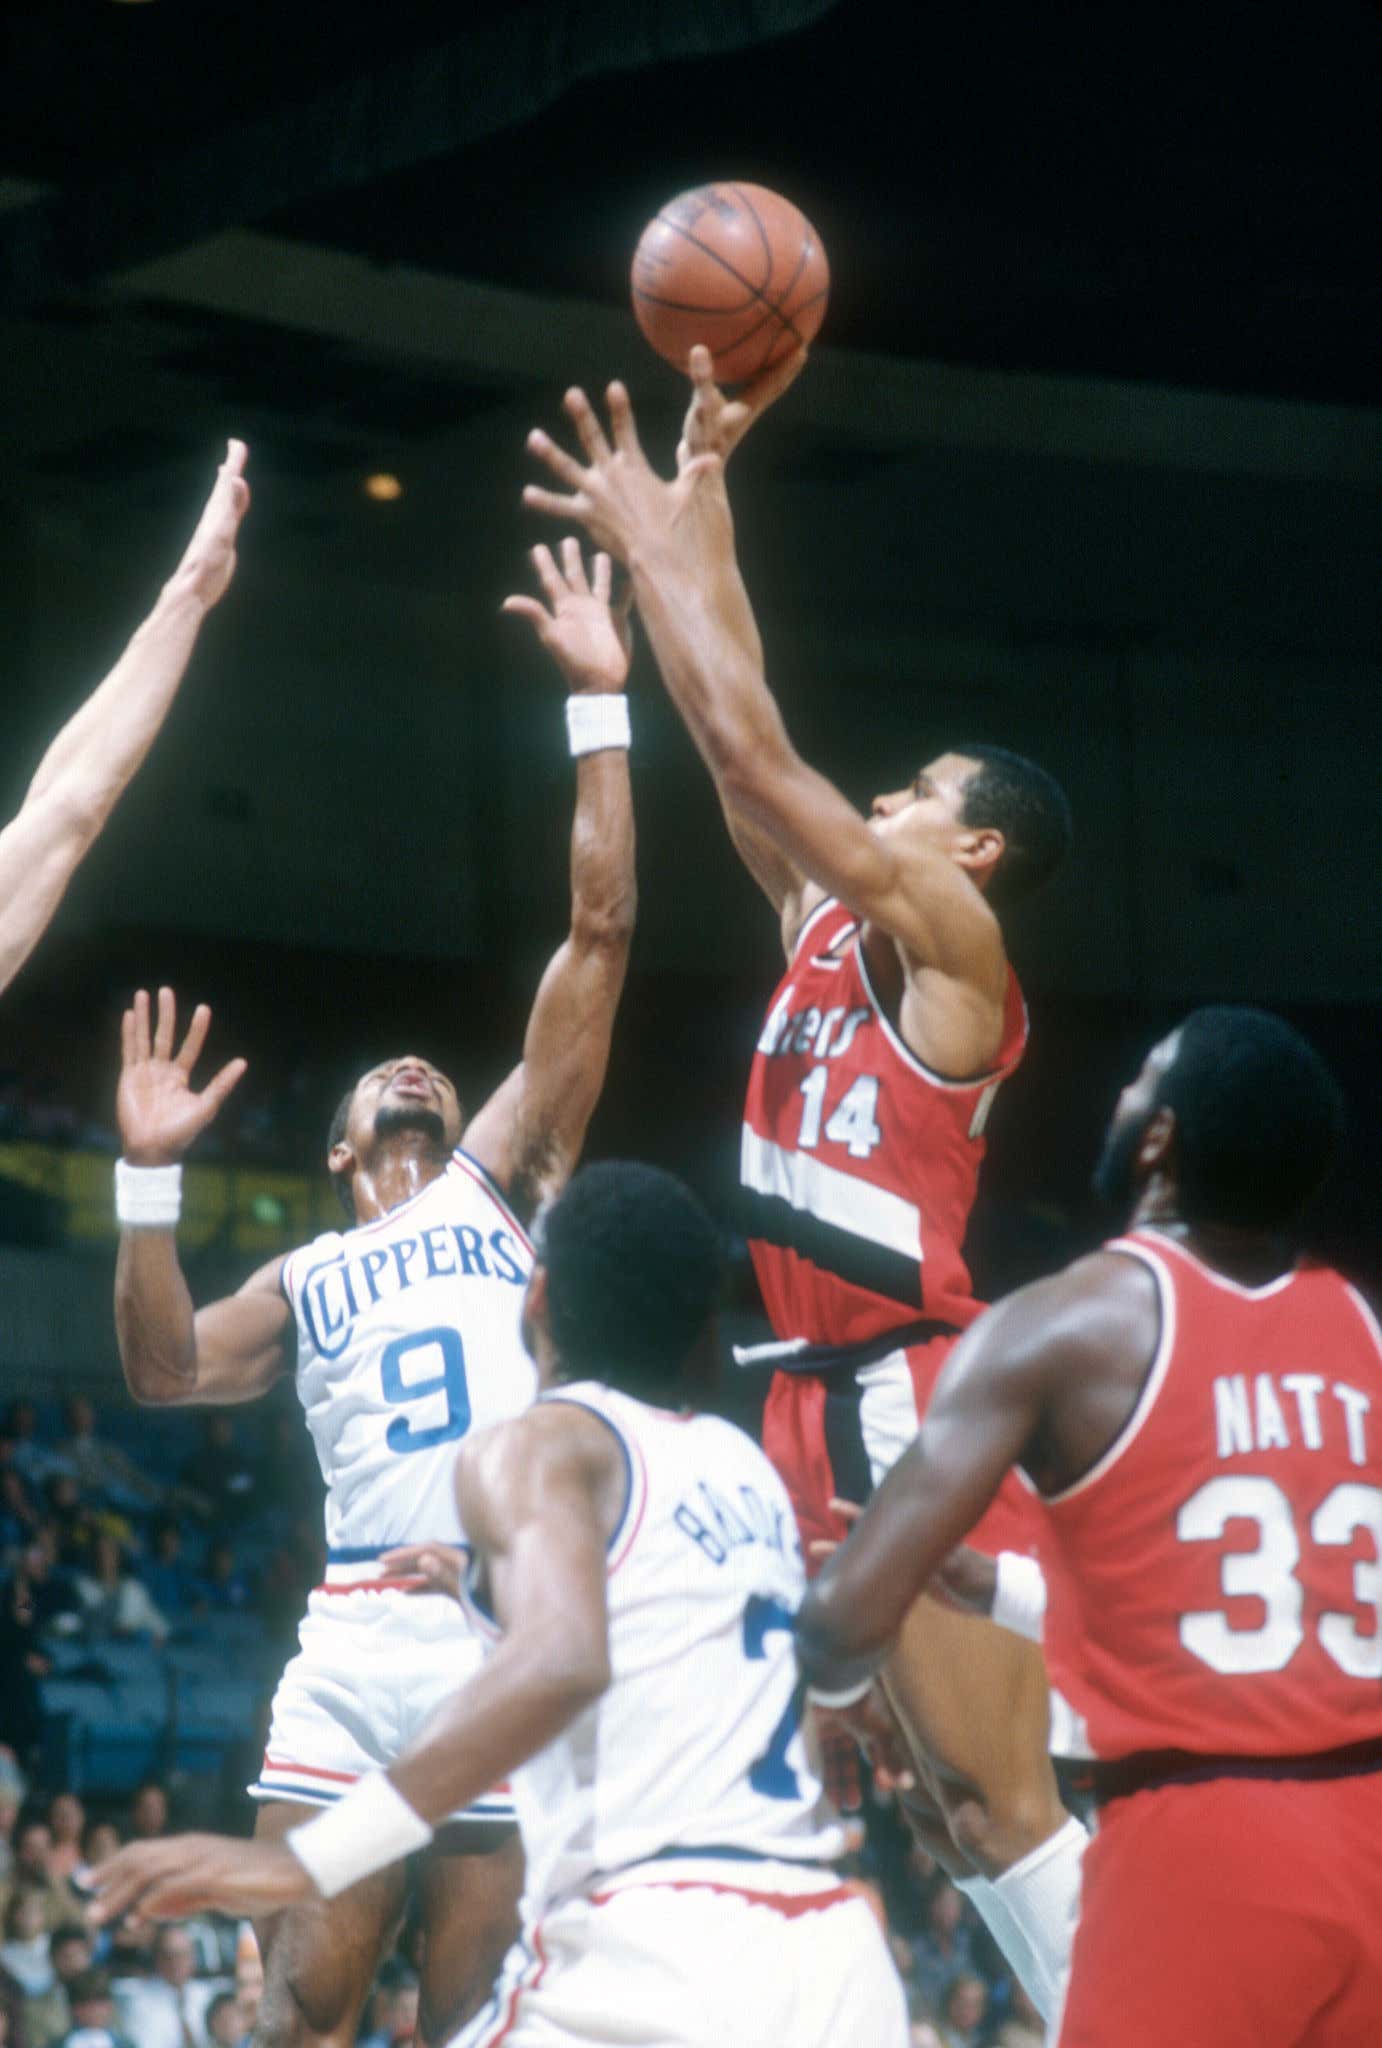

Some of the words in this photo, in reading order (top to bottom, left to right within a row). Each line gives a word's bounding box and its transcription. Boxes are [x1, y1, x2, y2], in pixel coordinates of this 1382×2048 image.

[797, 1063, 881, 1160] 14
[301, 1223, 528, 1361] CLIPPERS
[380, 1325, 472, 1455] 9
[1213, 1371, 1371, 1467] NATT
[1175, 1474, 1382, 1679] 33
